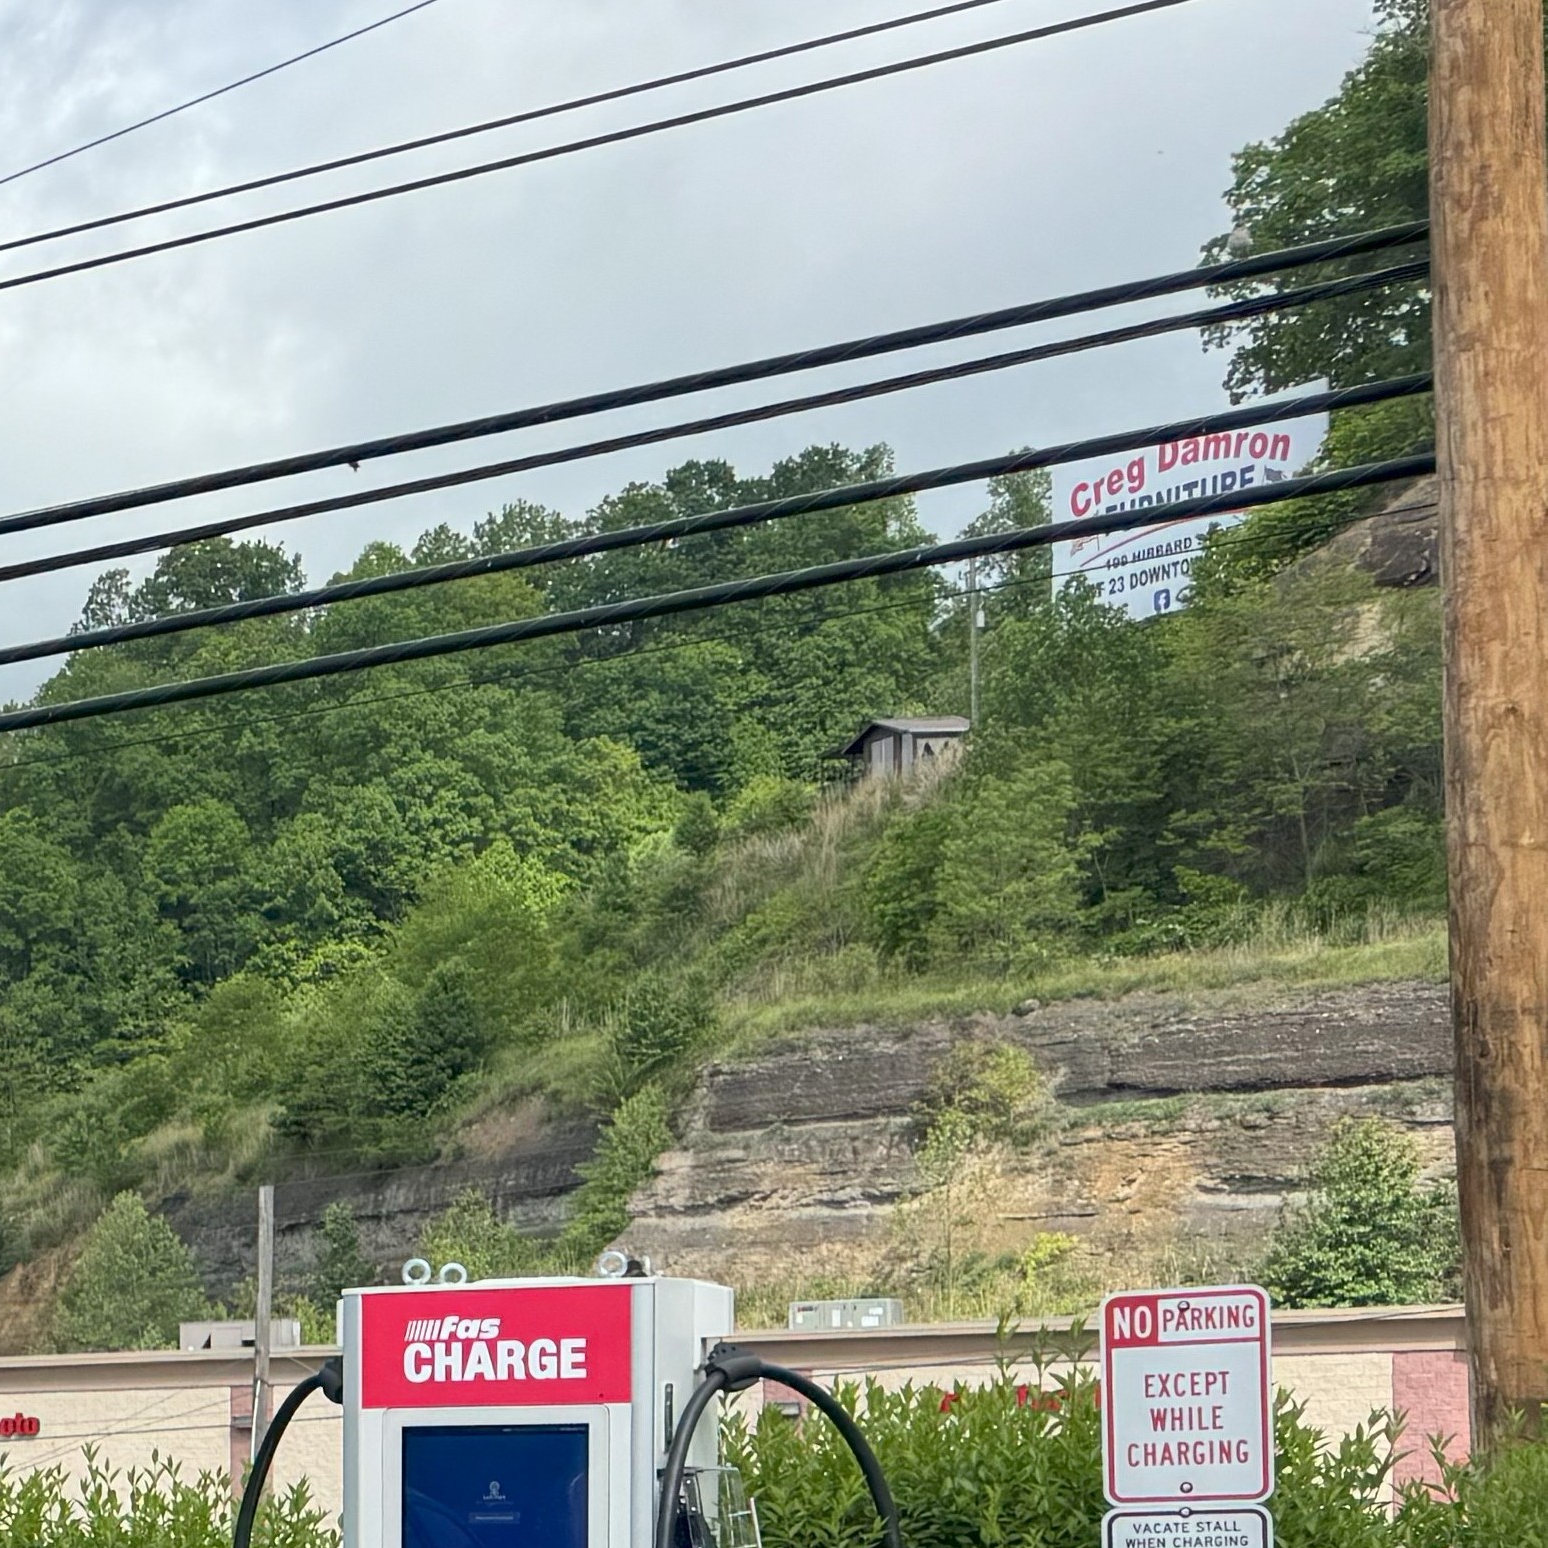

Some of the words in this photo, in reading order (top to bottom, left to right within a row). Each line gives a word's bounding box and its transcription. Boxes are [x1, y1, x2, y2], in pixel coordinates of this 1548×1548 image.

[1158, 431, 1291, 473] Damron
[1109, 576, 1125, 595] 23
[1130, 556, 1202, 590] DOWNTO
[1112, 1305, 1153, 1341] NO
[1162, 1304, 1255, 1333] PARKING
[403, 1337, 588, 1384] CHARGE
[1144, 1371, 1230, 1398] EXCEPT
[1150, 1406, 1224, 1432] WHILE
[1127, 1439, 1250, 1467] CHARGING
[1132, 1522, 1189, 1534] VACATE
[1196, 1521, 1241, 1533] STALL
[1125, 1537, 1166, 1548] WHEN
[1173, 1536, 1248, 1548] CHARGING
